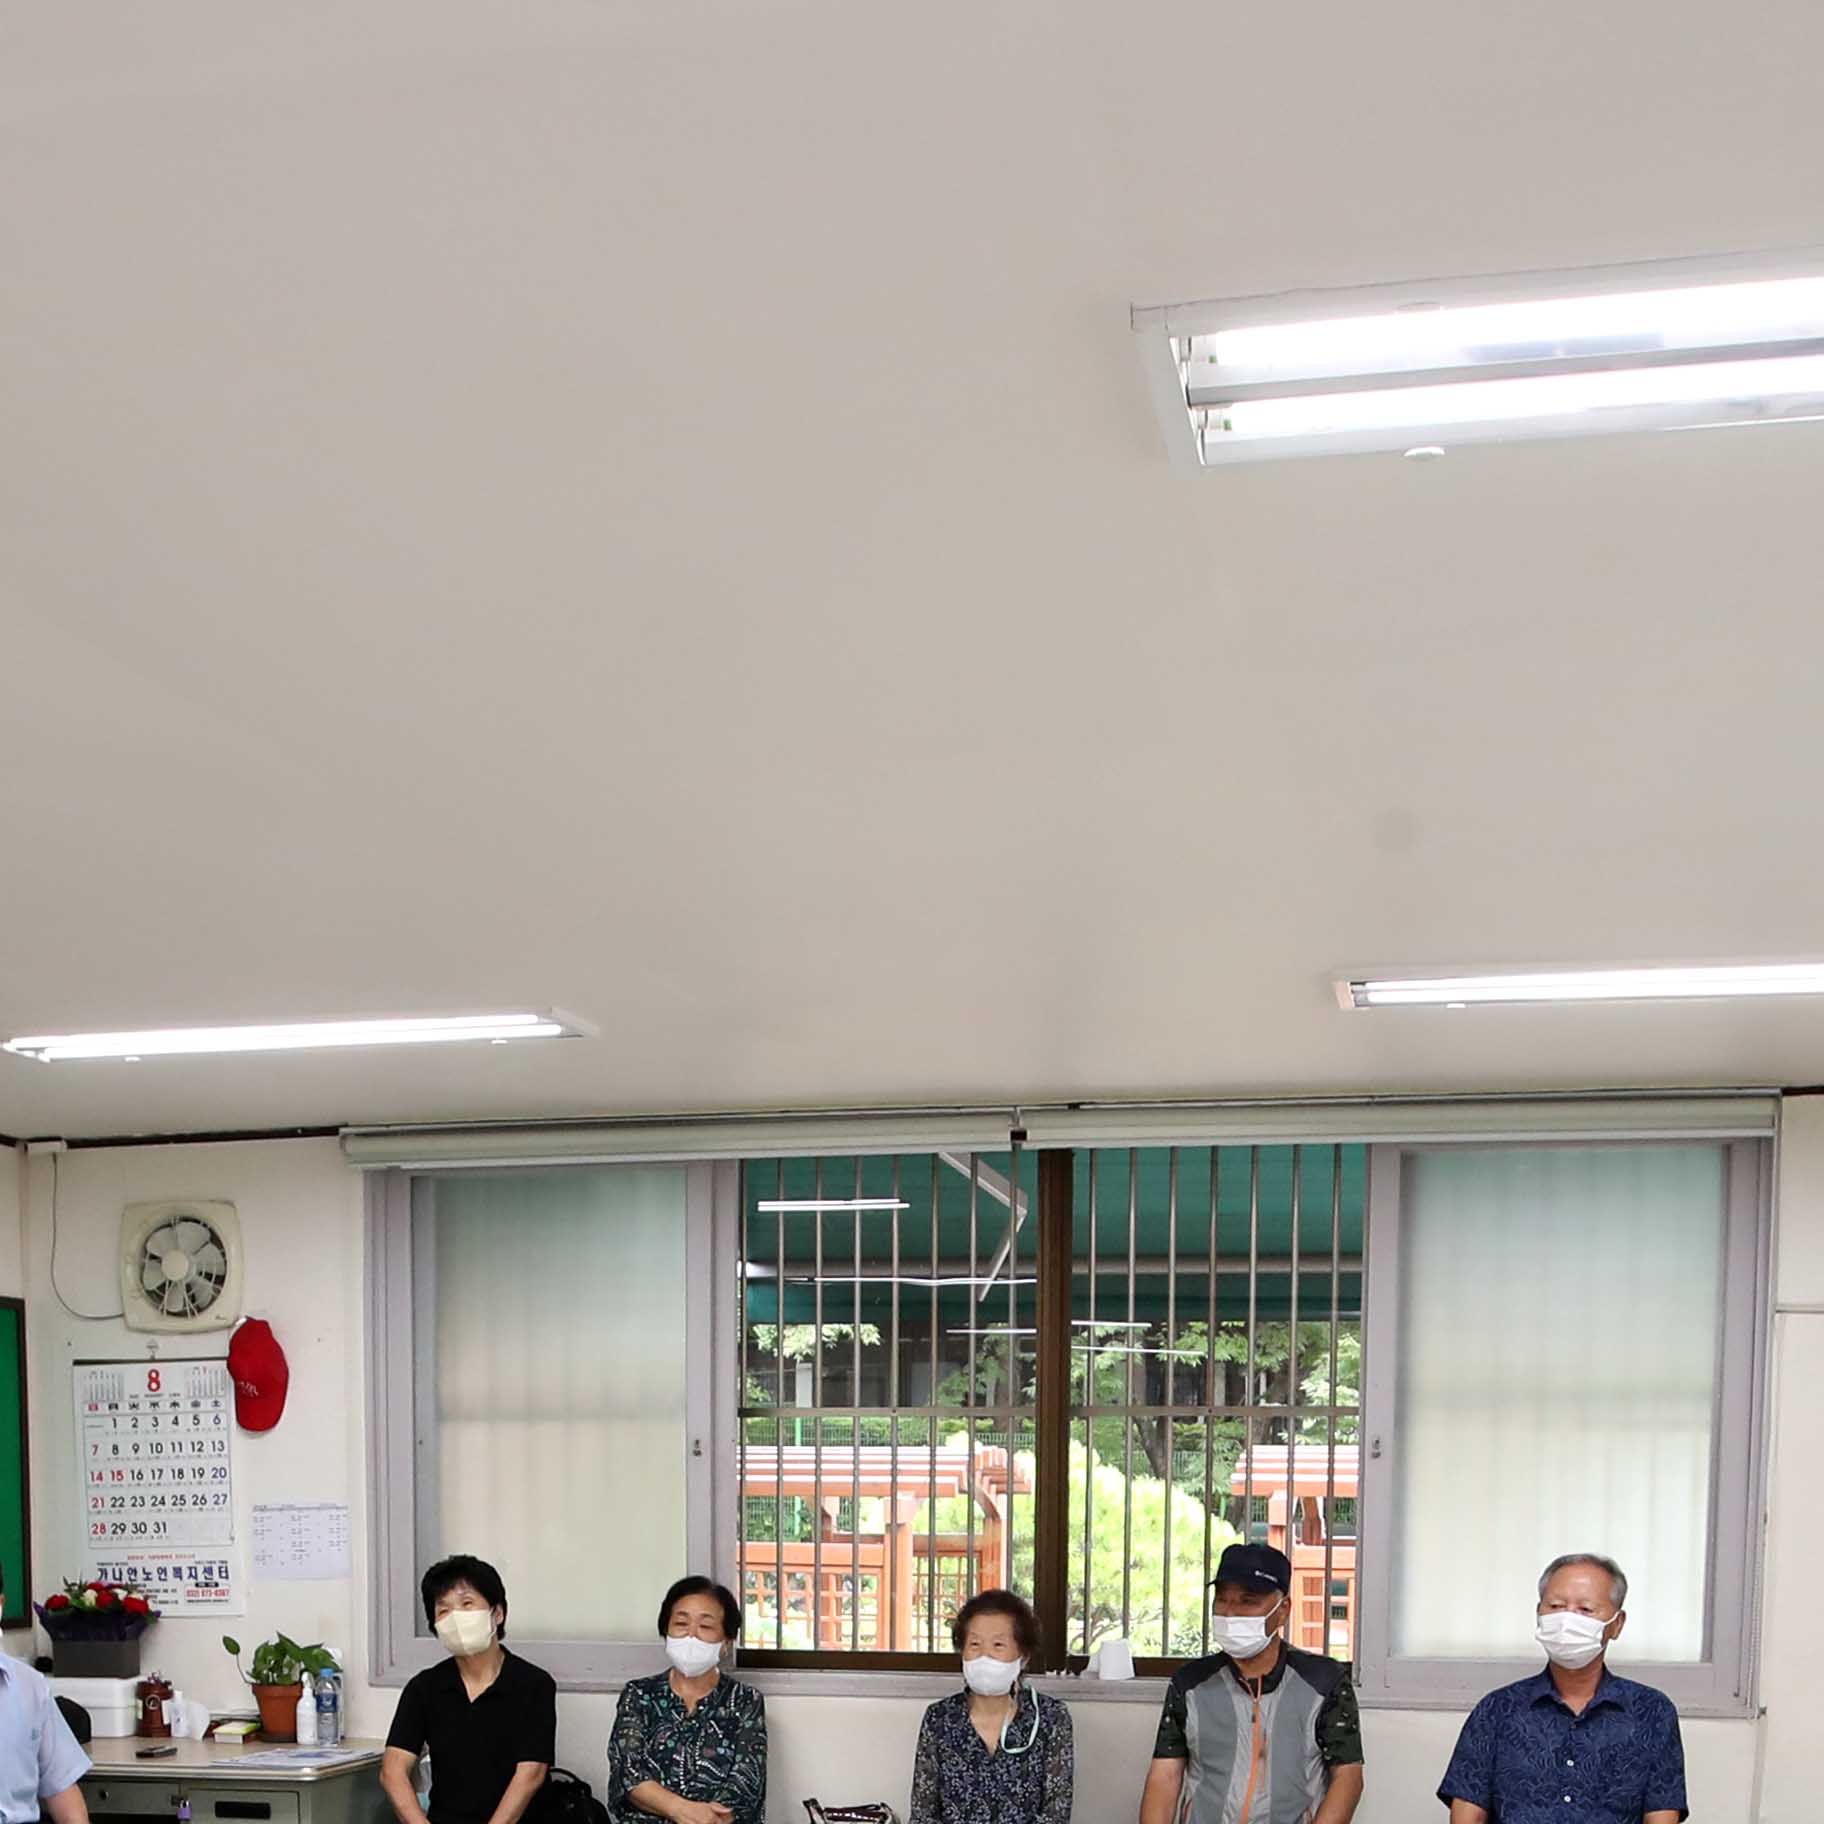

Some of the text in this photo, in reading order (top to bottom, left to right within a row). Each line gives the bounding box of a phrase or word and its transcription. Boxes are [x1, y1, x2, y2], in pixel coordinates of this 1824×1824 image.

[147, 1369, 161, 1392] 8
[112, 1414, 222, 1428] 1 2 3 4 5 6
[92, 1440, 226, 1456] 7 8 9 10 11 12 13
[90, 1466, 228, 1482] 14 15 16 17 18 19 20
[92, 1494, 228, 1508] 21 22 23 24 25 26 27
[92, 1522, 168, 1536] 28 29 30 31
